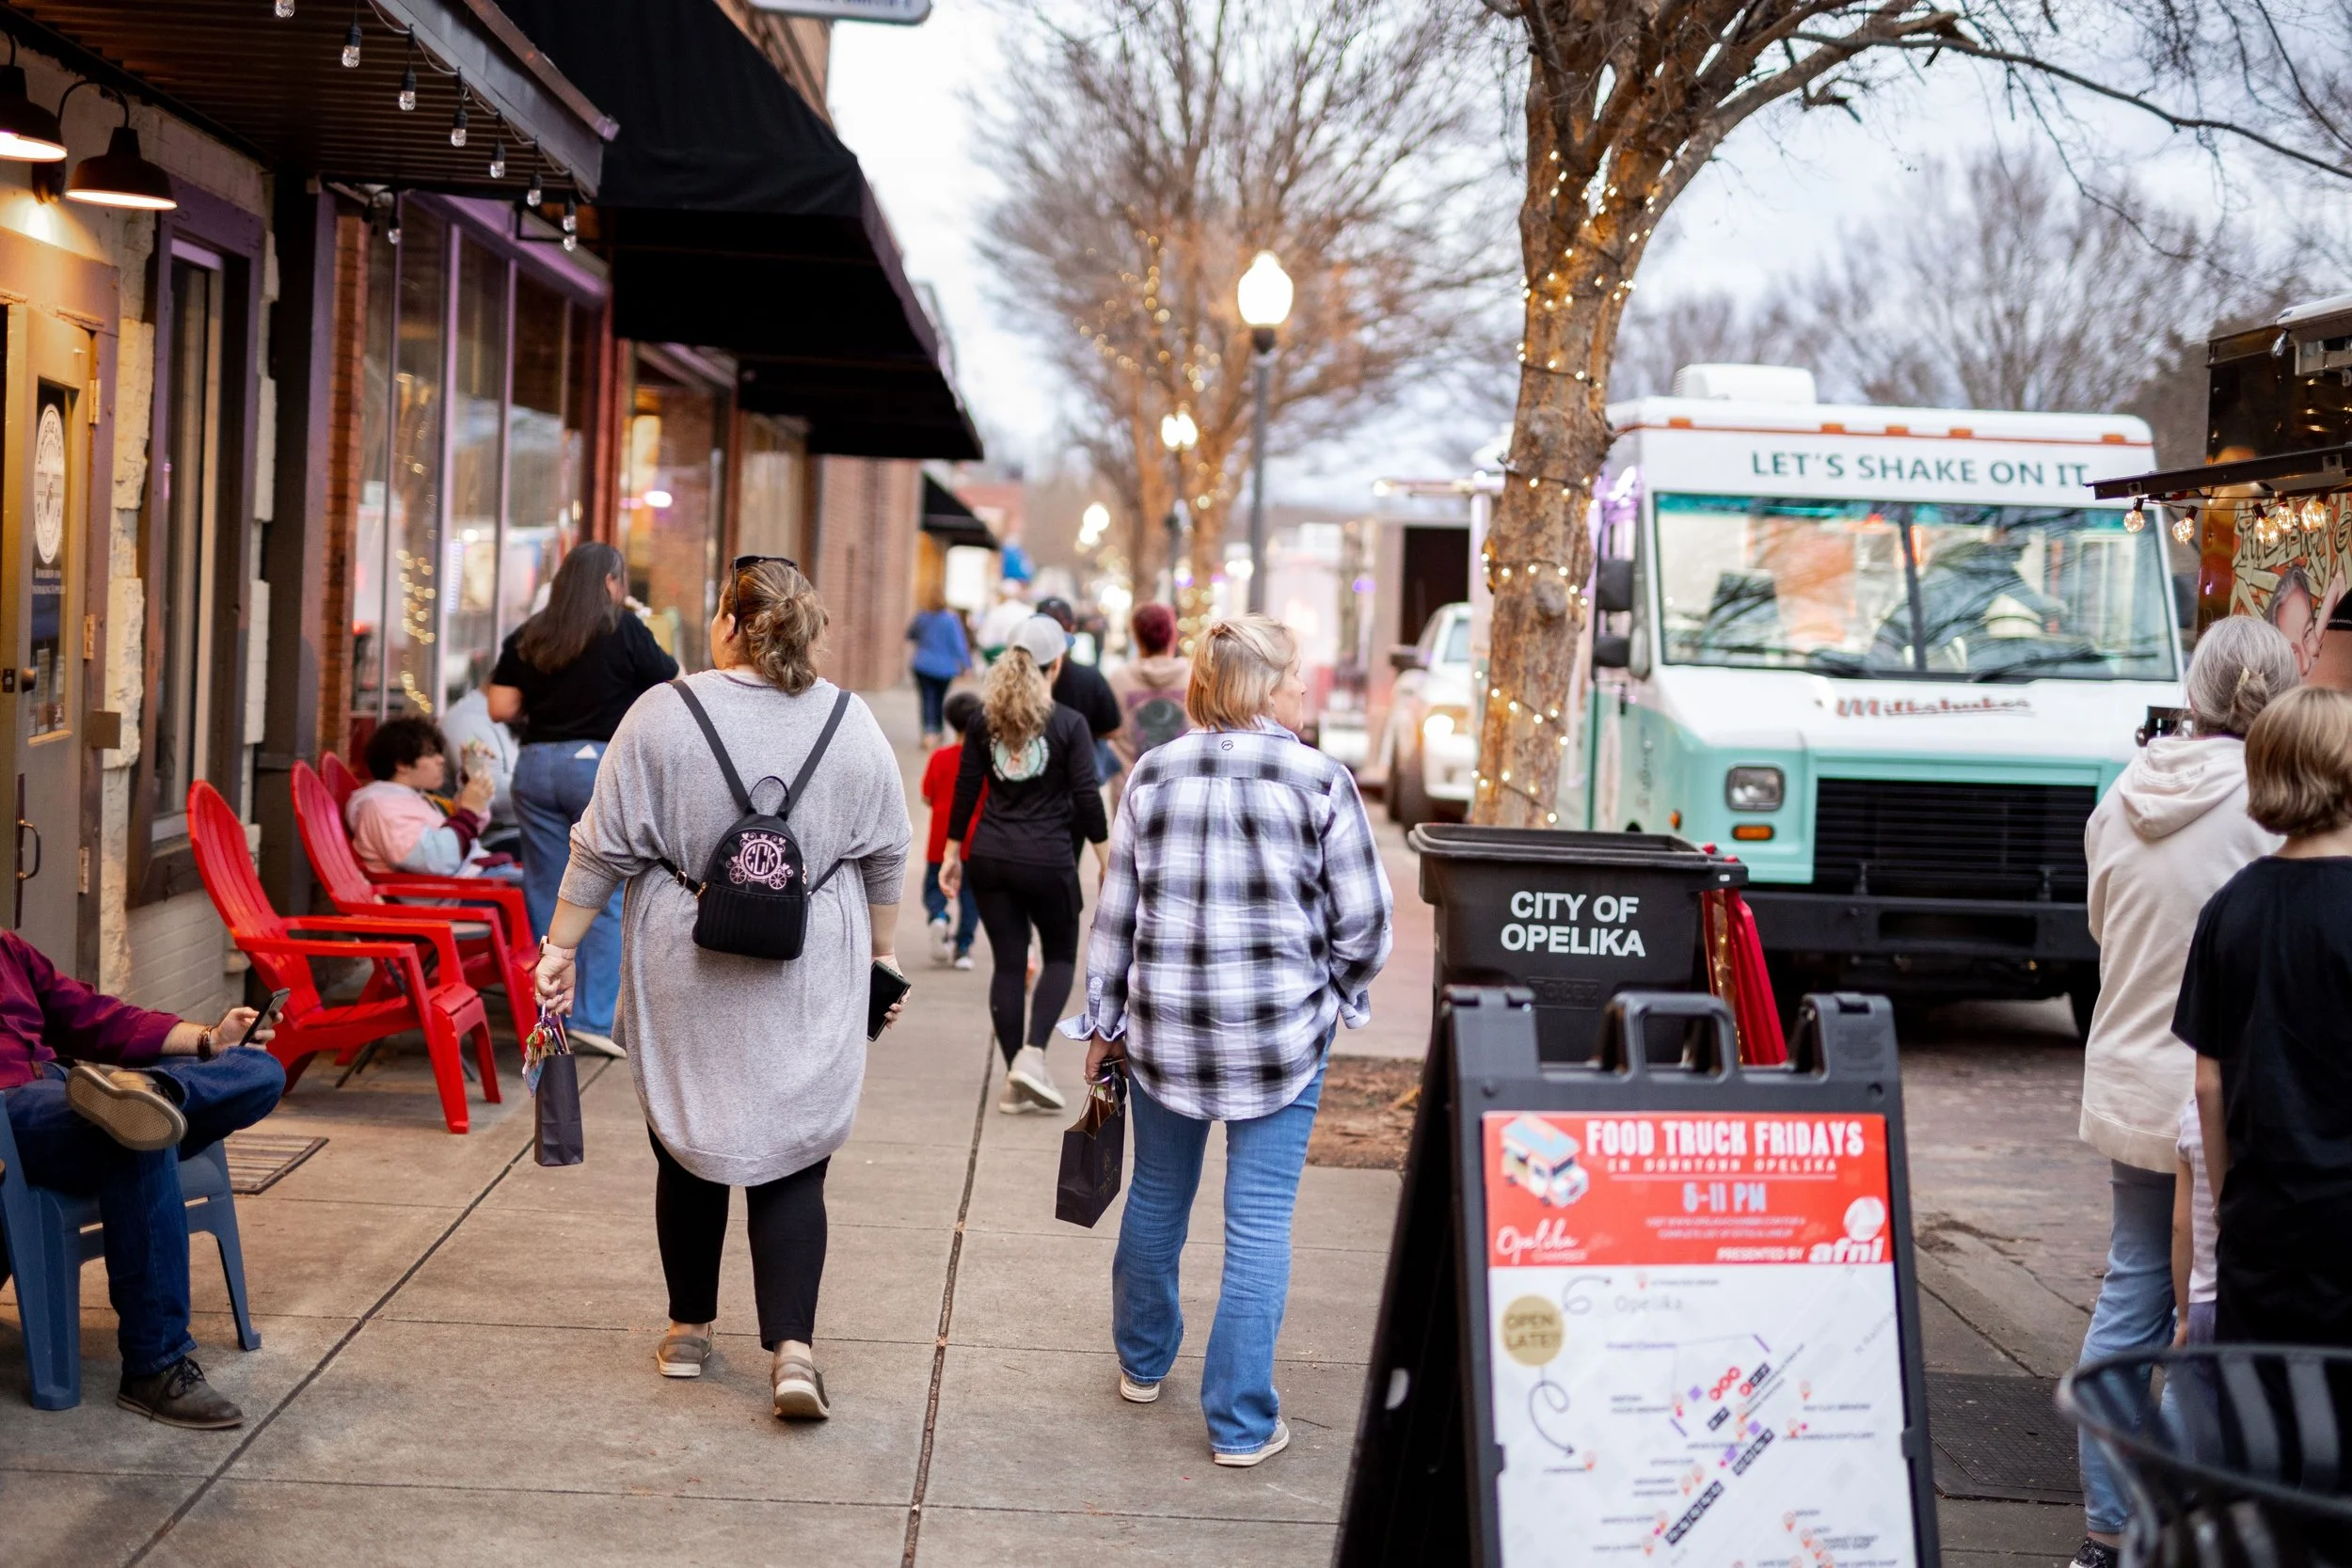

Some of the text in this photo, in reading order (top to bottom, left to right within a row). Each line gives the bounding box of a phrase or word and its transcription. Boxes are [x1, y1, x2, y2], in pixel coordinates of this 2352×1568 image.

[1752, 451, 2089, 486] LET'S SHAKE ON IT
[745, 843, 775, 875] ECK
[1510, 891, 1640, 924] CITY OF
[1501, 923, 1646, 958] OPELIKA
[1585, 1119, 1865, 1157] FOOD TRUCK FRIDAYS
[1643, 1158, 1741, 1173] DOWNTOWN
[1754, 1158, 1836, 1173] OPELIKA
[1733, 1181, 1768, 1212] PM
[1715, 1246, 1786, 1262] PRESENTED
[1808, 1237, 1884, 1263] afni
